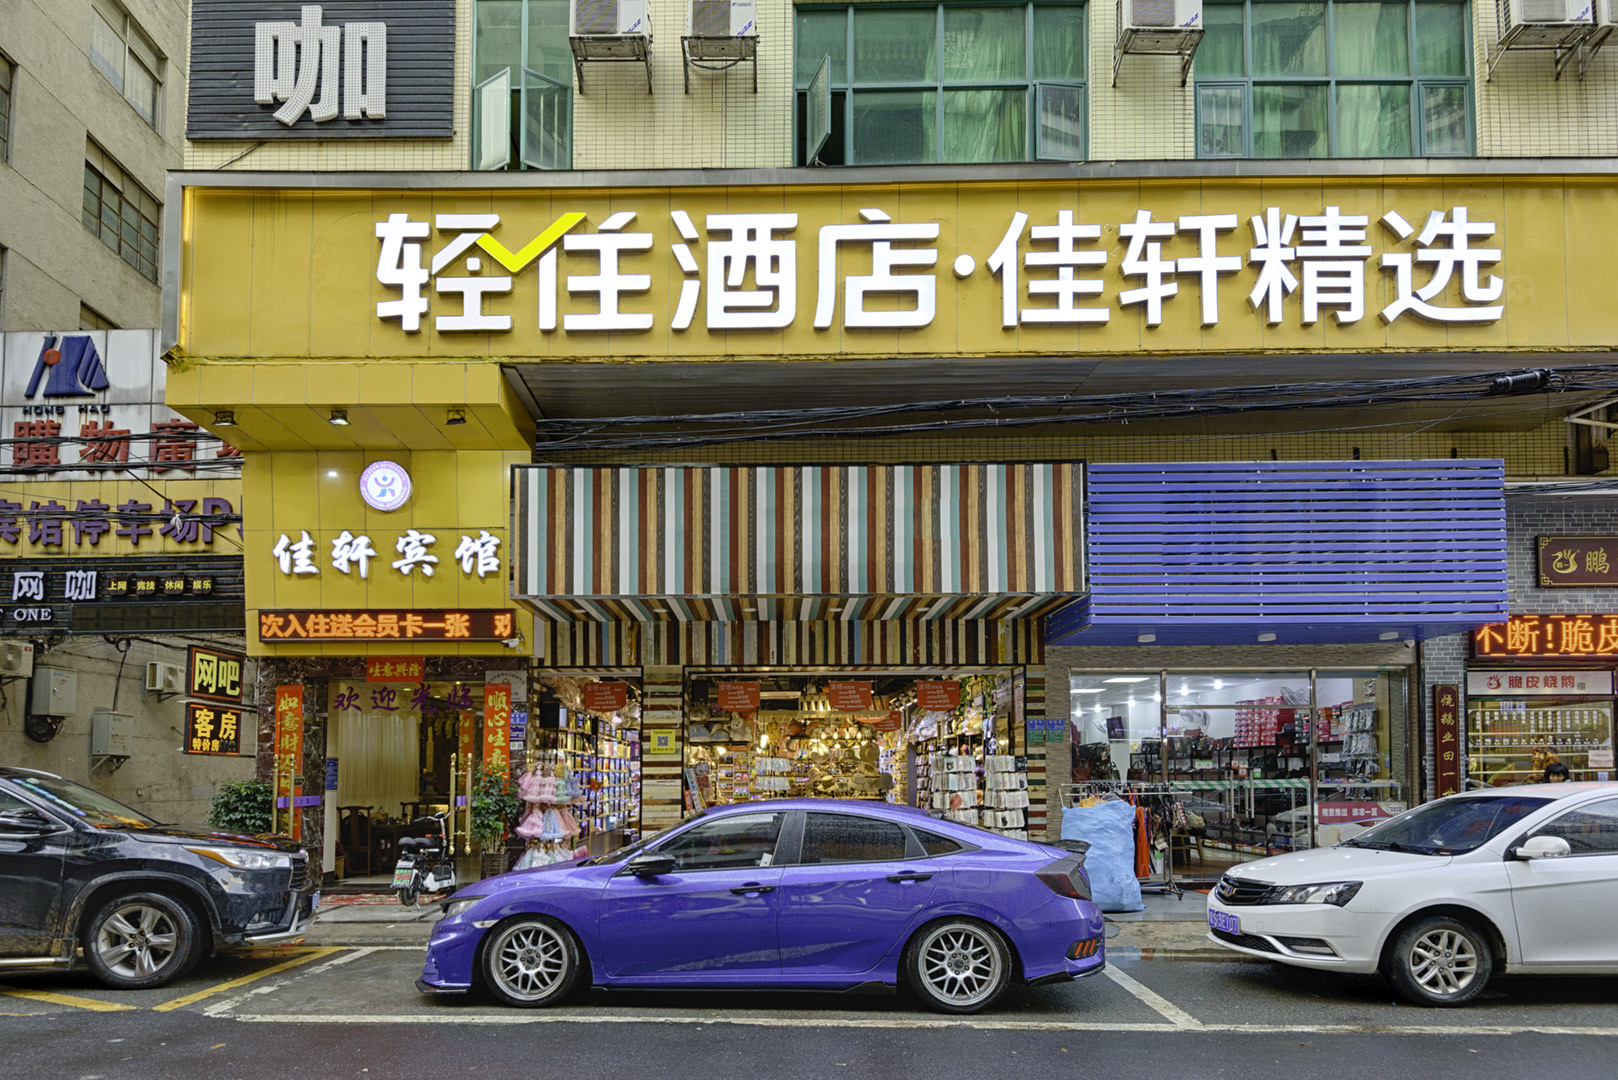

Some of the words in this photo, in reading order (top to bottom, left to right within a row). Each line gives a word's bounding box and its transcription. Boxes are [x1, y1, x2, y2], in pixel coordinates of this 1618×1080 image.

[254, 5, 387, 126] 咖
[23, 405, 65, 415] HONG
[273, 530, 502, 579] 佳轩宾馆
[12, 571, 97, 600] 网咖
[108, 581, 127, 590] 上网
[14, 608, 51, 621] ONE
[261, 614, 470, 637] 次入住送会员卡一张
[194, 652, 240, 696] 网吧
[1508, 675, 1575, 689] 脆皮烧鹅
[333, 682, 474, 713] 欢迎光临
[194, 708, 237, 740] 客房
[192, 738, 220, 752] 特价房
